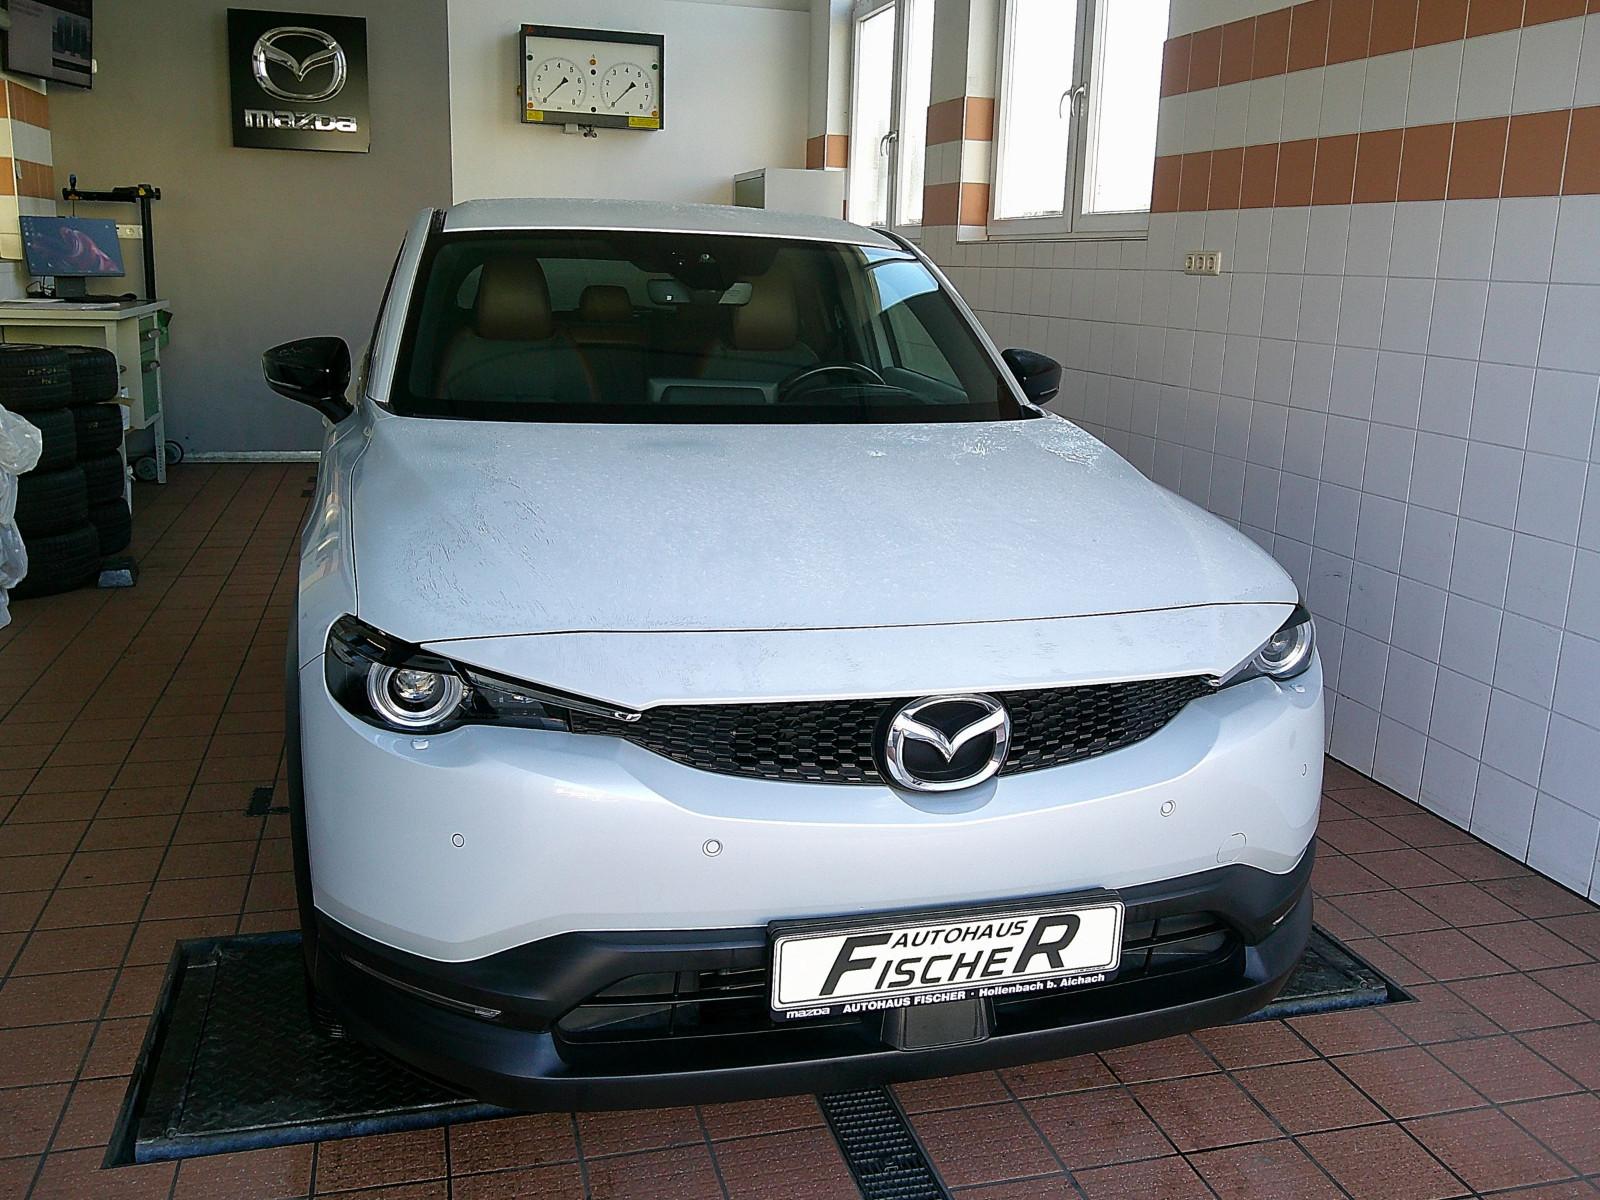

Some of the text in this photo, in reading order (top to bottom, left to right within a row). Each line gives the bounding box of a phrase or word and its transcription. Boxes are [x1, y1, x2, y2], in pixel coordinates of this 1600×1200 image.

[244, 109, 357, 133] mazda
[892, 920, 1028, 949] AUTOHAUS
[819, 913, 1081, 996] FISCHER
[786, 974, 1105, 1019] mazda AUTOHAUS FISCHER Hollenbach b. Aichach
